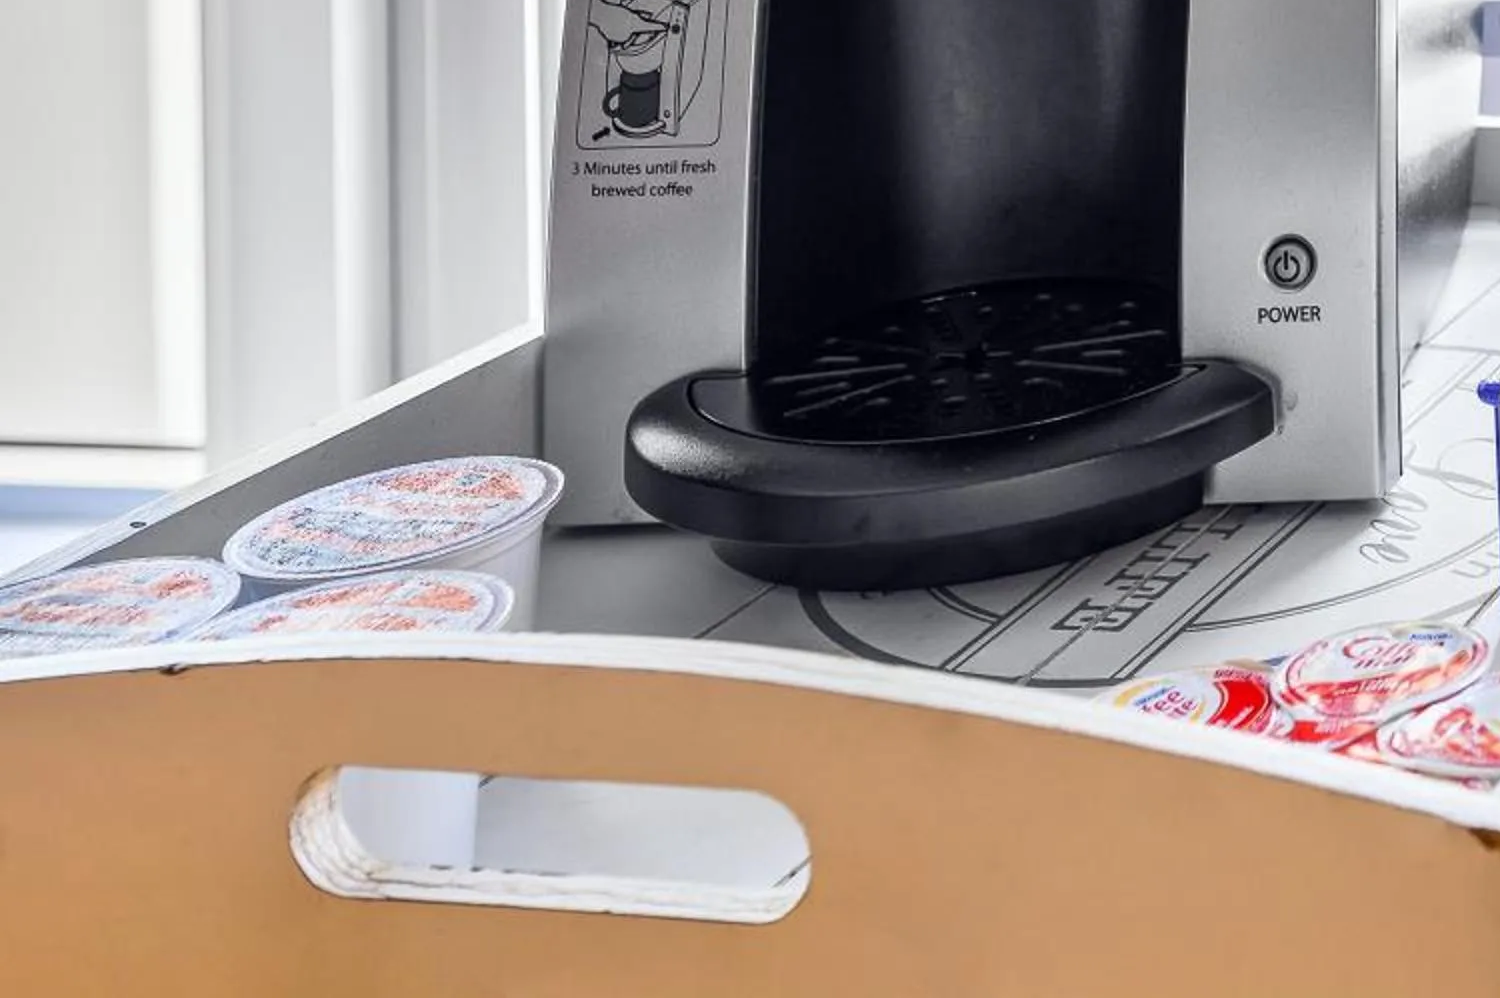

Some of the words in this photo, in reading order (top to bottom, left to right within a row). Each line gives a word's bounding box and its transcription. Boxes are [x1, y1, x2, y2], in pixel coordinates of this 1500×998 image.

[571, 162, 580, 176] 3
[583, 161, 642, 176] Minutes
[645, 160, 677, 175] until
[680, 160, 717, 175] fresh
[591, 182, 646, 198] brewed
[649, 182, 693, 198] coffee
[1257, 305, 1321, 324] POWER
